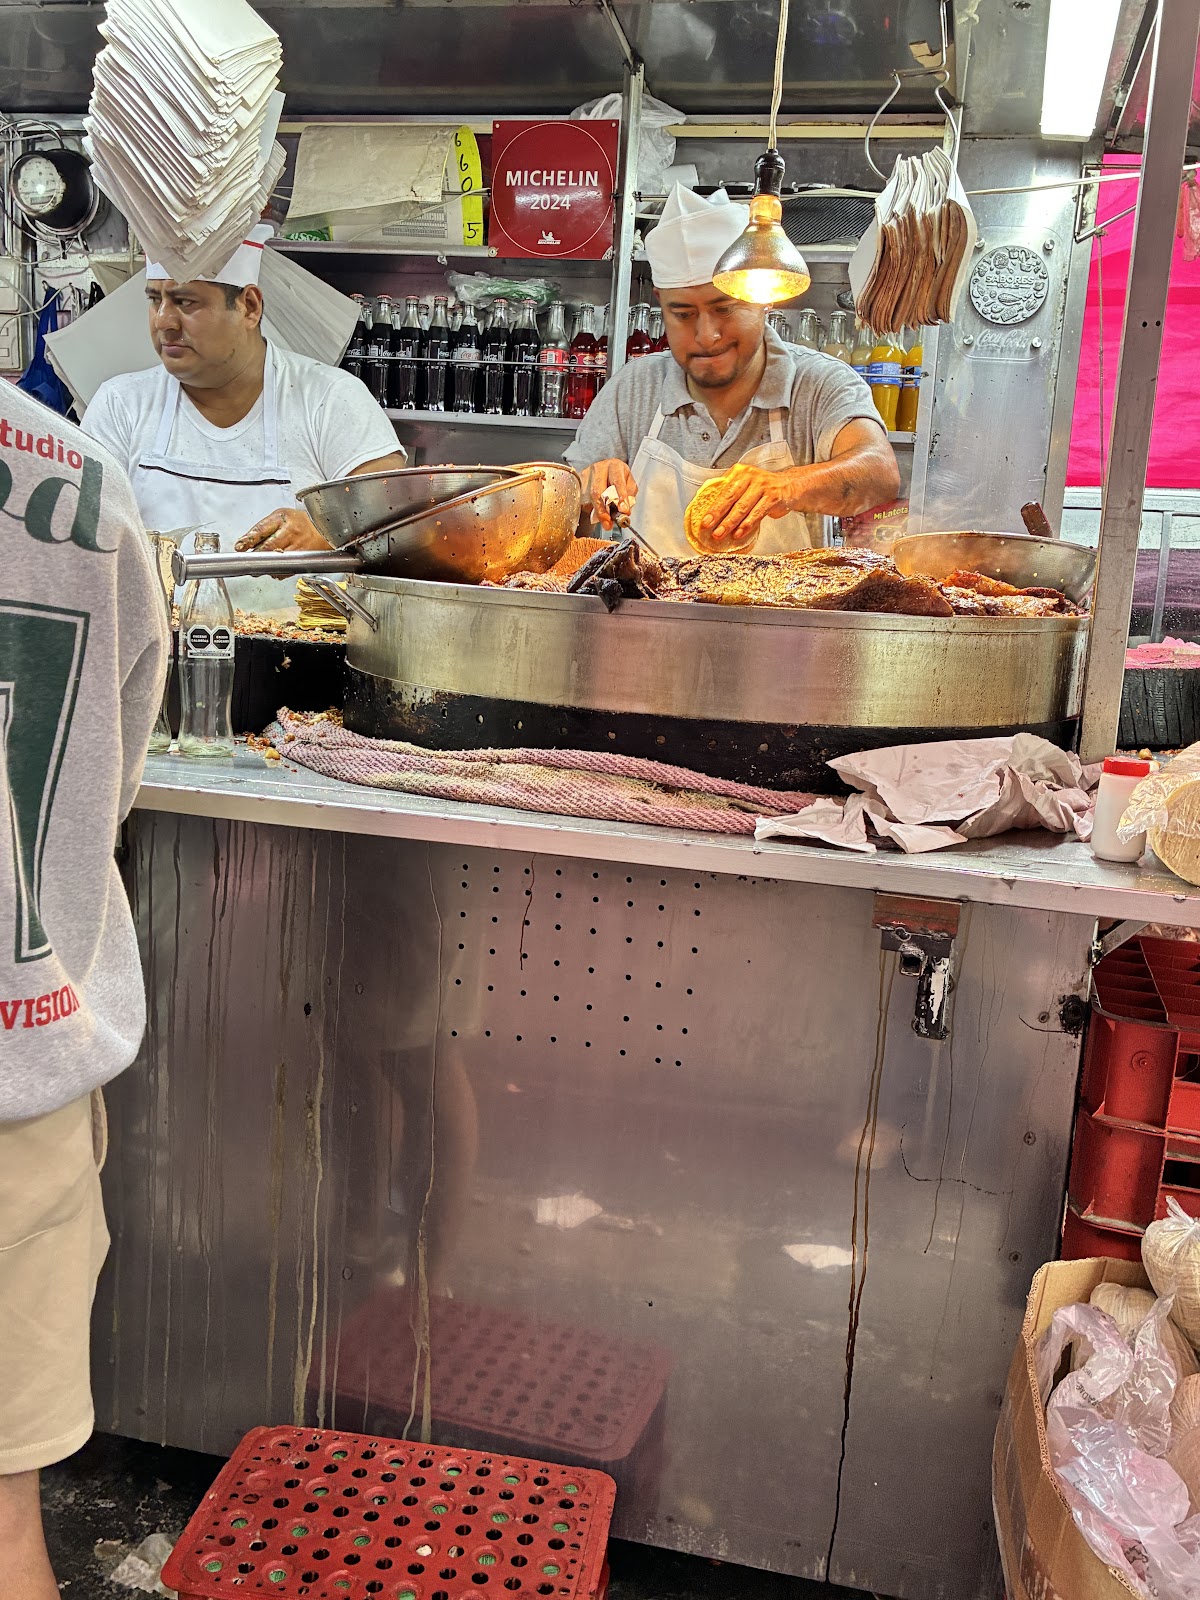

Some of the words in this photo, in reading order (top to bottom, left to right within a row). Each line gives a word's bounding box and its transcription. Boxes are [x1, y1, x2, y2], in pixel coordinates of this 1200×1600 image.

[506, 170, 598, 187] MICHELIN
[530, 194, 571, 210] 2024
[985, 275, 1035, 284] SABORES
